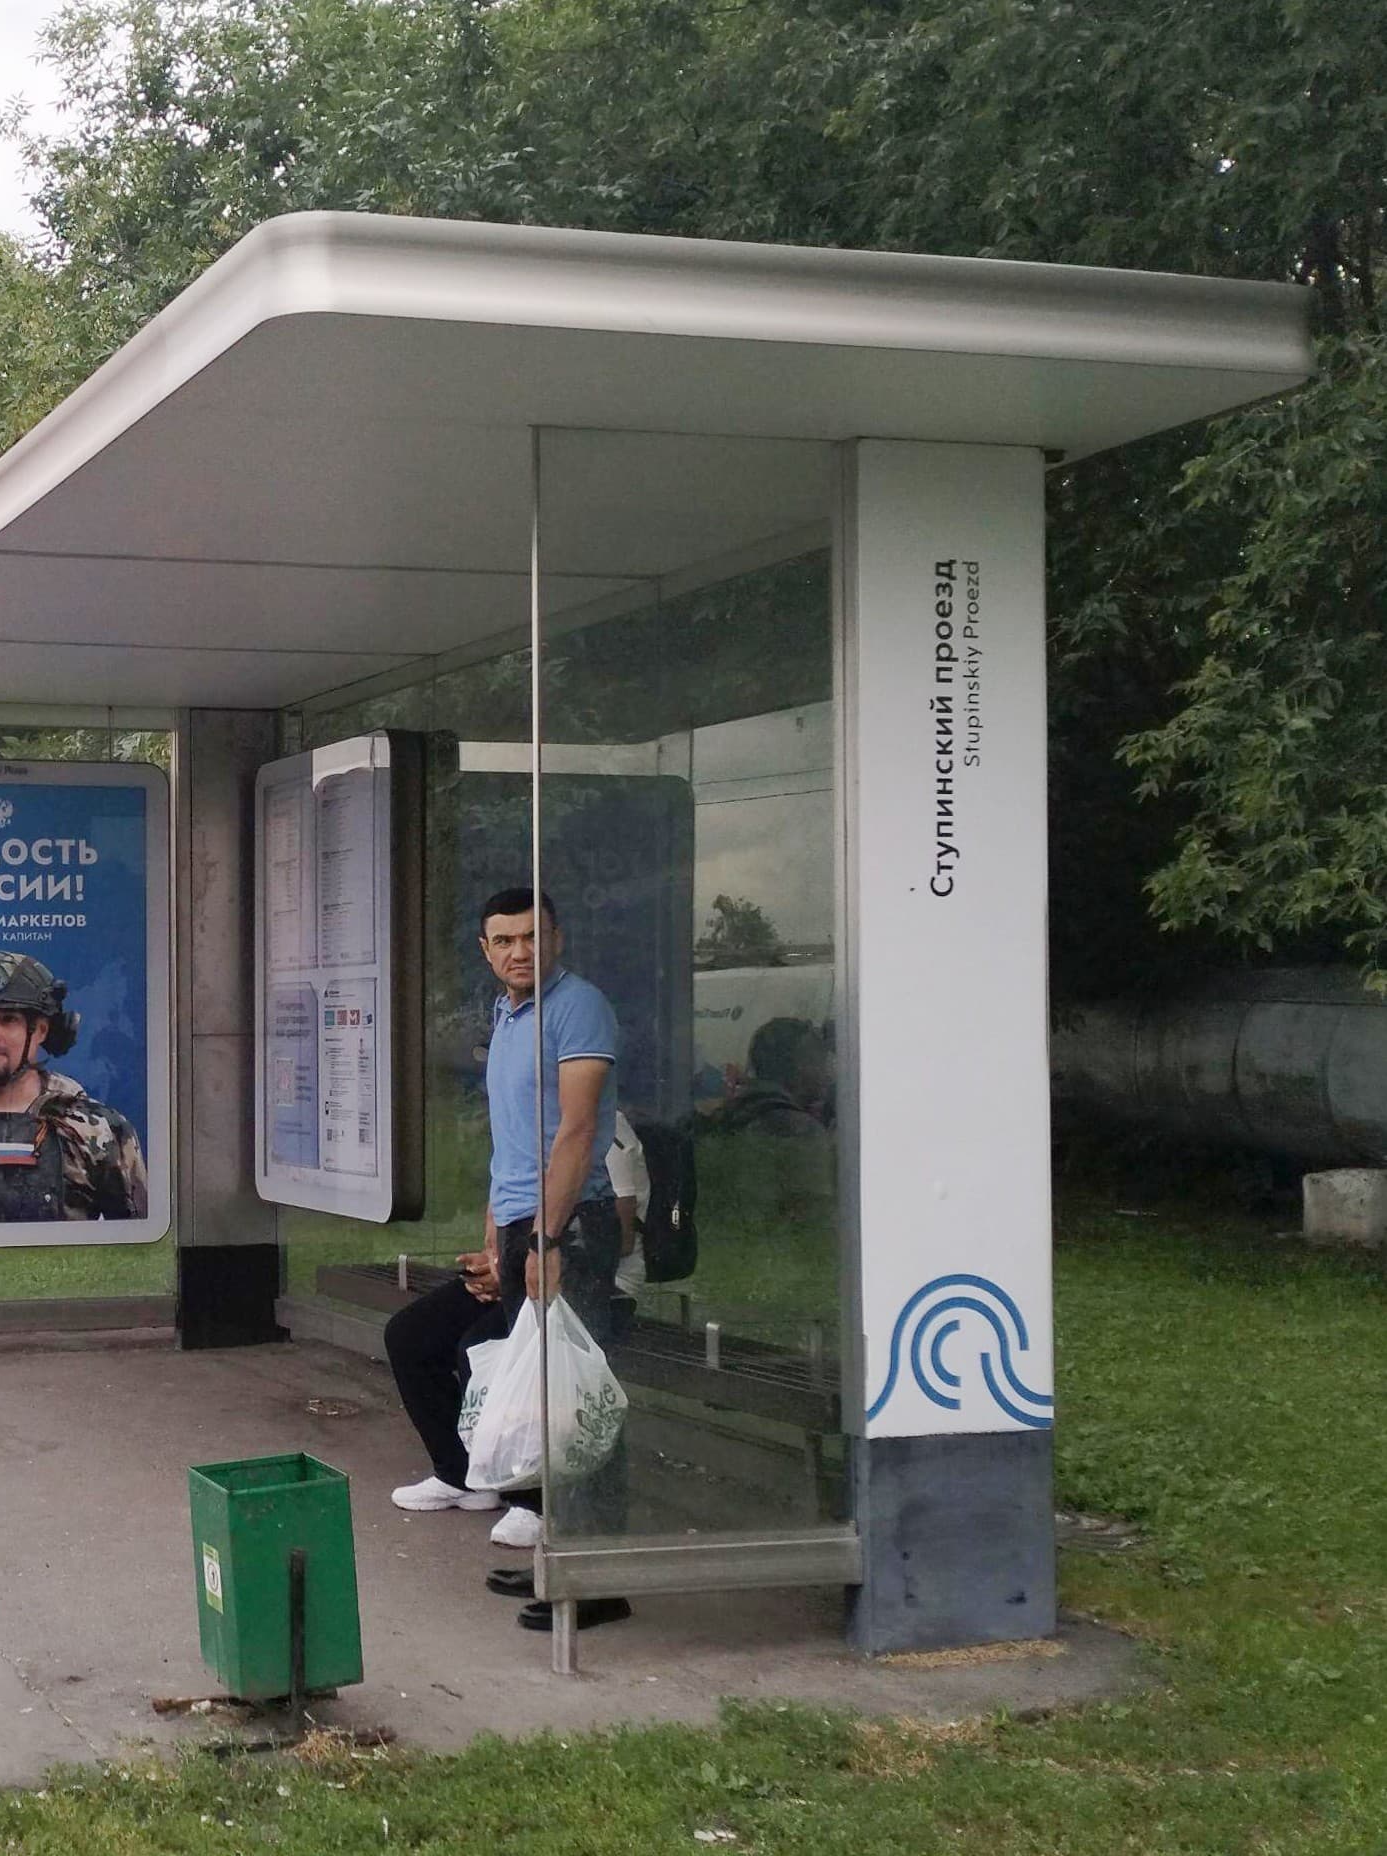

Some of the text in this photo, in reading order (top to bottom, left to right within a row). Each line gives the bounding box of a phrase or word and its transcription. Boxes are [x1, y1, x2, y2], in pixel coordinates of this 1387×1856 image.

[929, 559, 960, 897] Ступинский проезд
[962, 561, 984, 767] Stupinskiy Proezd
[2, 932, 53, 942] КАПИТАН
